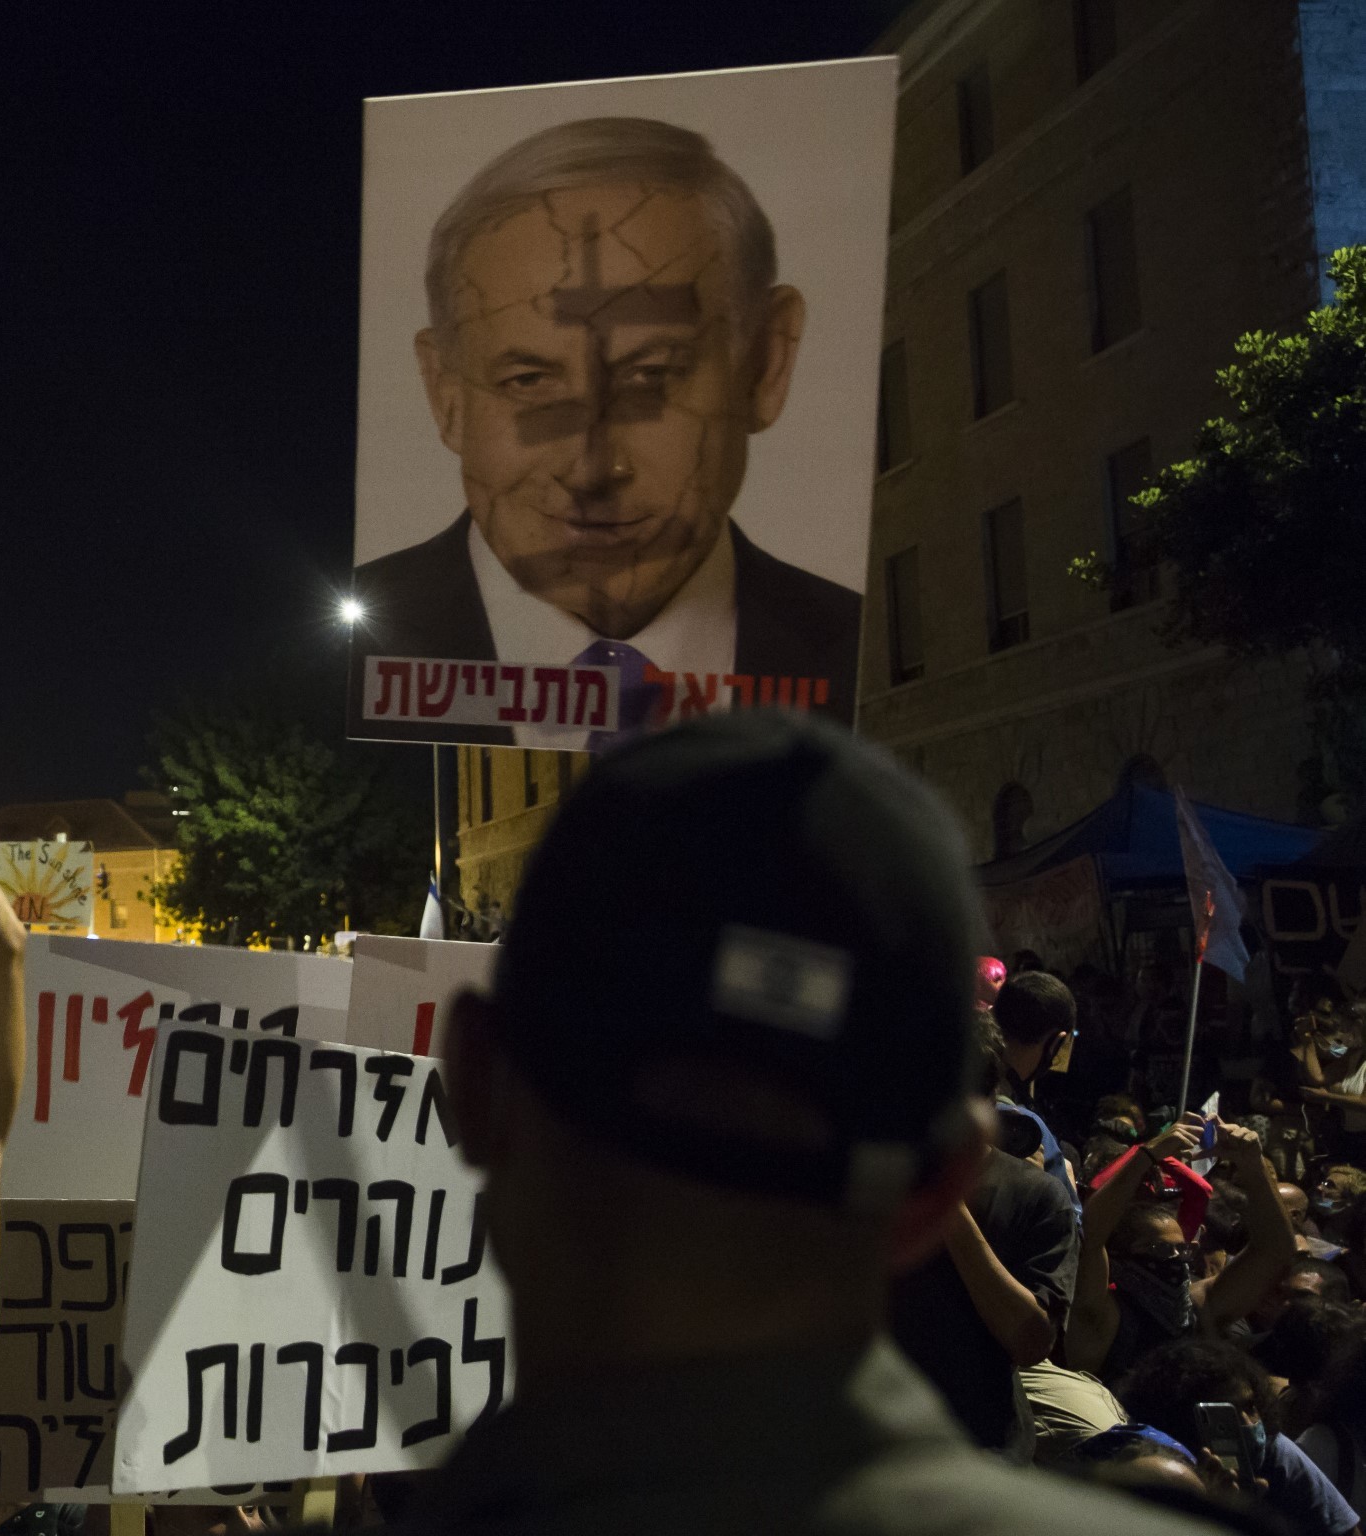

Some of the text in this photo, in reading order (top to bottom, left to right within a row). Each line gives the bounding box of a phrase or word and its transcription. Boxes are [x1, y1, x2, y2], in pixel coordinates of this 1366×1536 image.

[375, 661, 608, 726] מתביישת
[7, 844, 31, 862] The
[221, 1172, 487, 1285] נוהרים
[163, 1297, 506, 1466] לכיכרות
